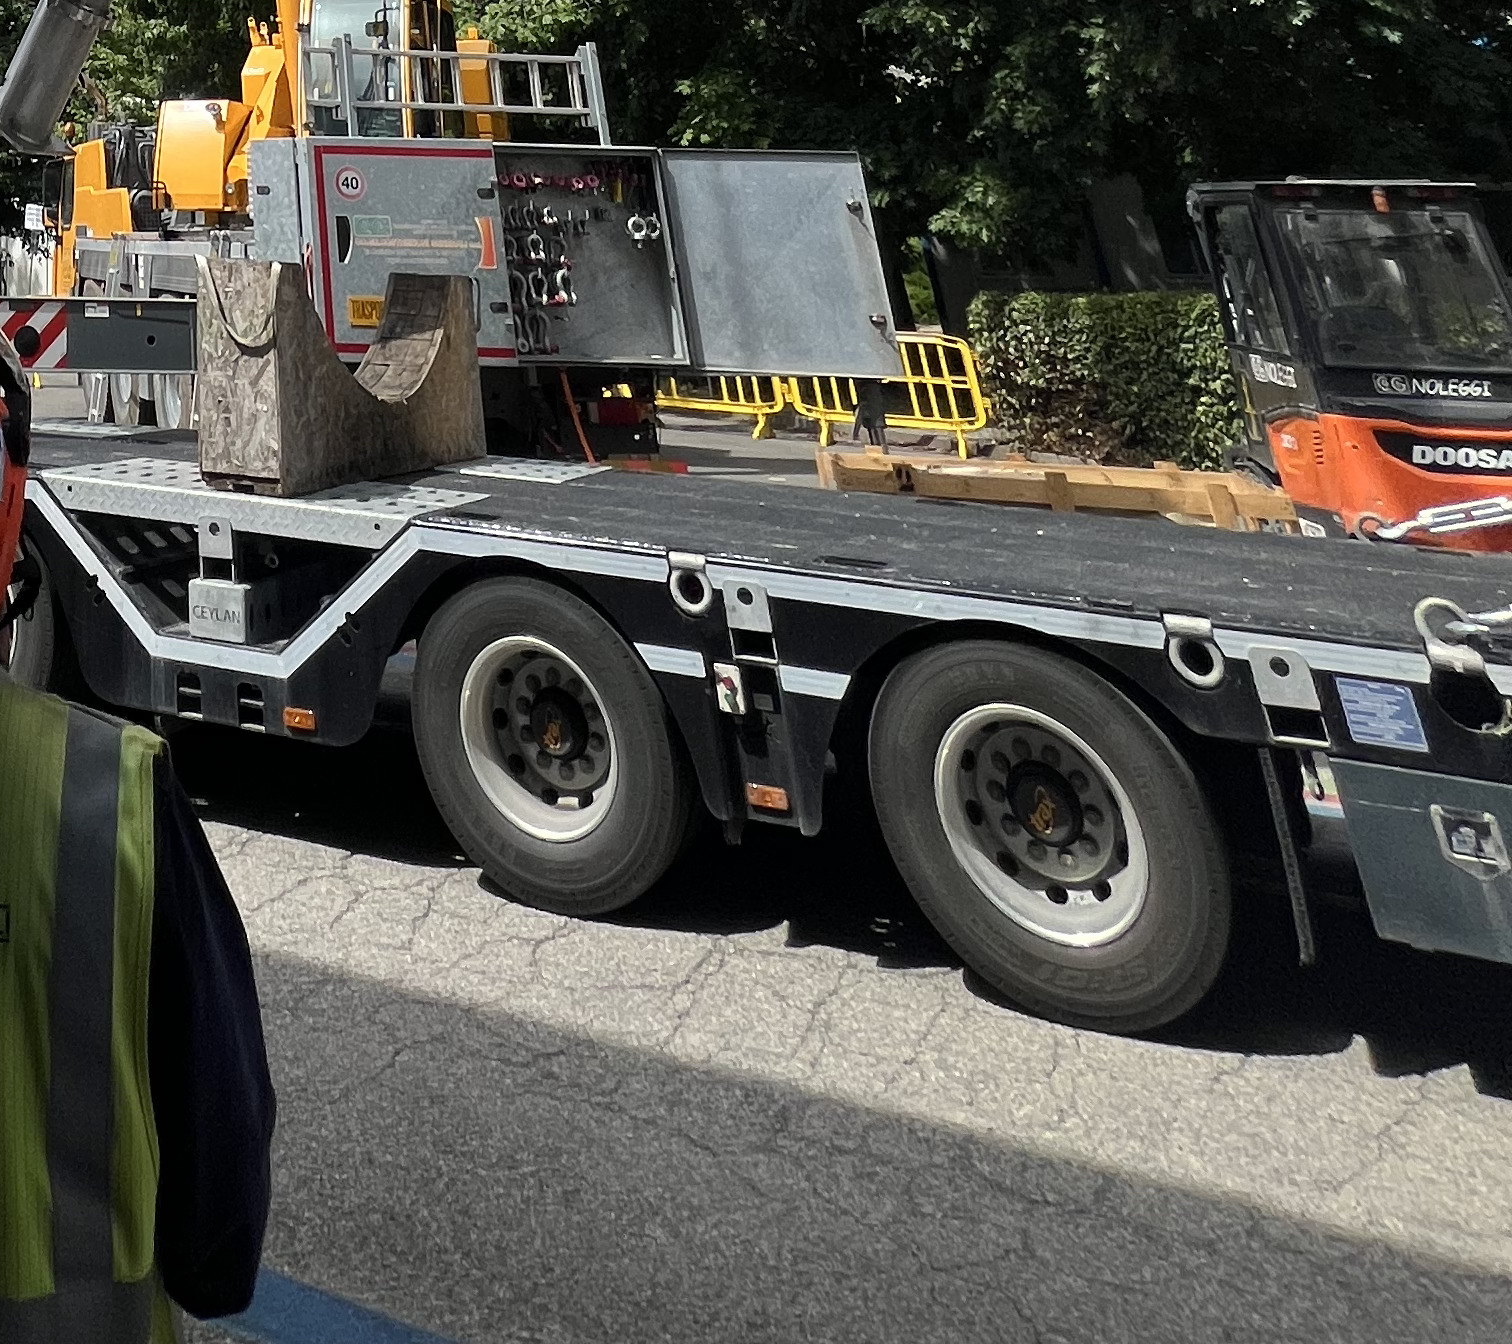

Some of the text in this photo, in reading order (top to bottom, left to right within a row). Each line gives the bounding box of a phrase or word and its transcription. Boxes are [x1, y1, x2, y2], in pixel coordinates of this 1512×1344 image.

[341, 176, 359, 190] 40
[1411, 377, 1492, 397] NOLEGGI
[192, 604, 241, 625] CEYLAN
